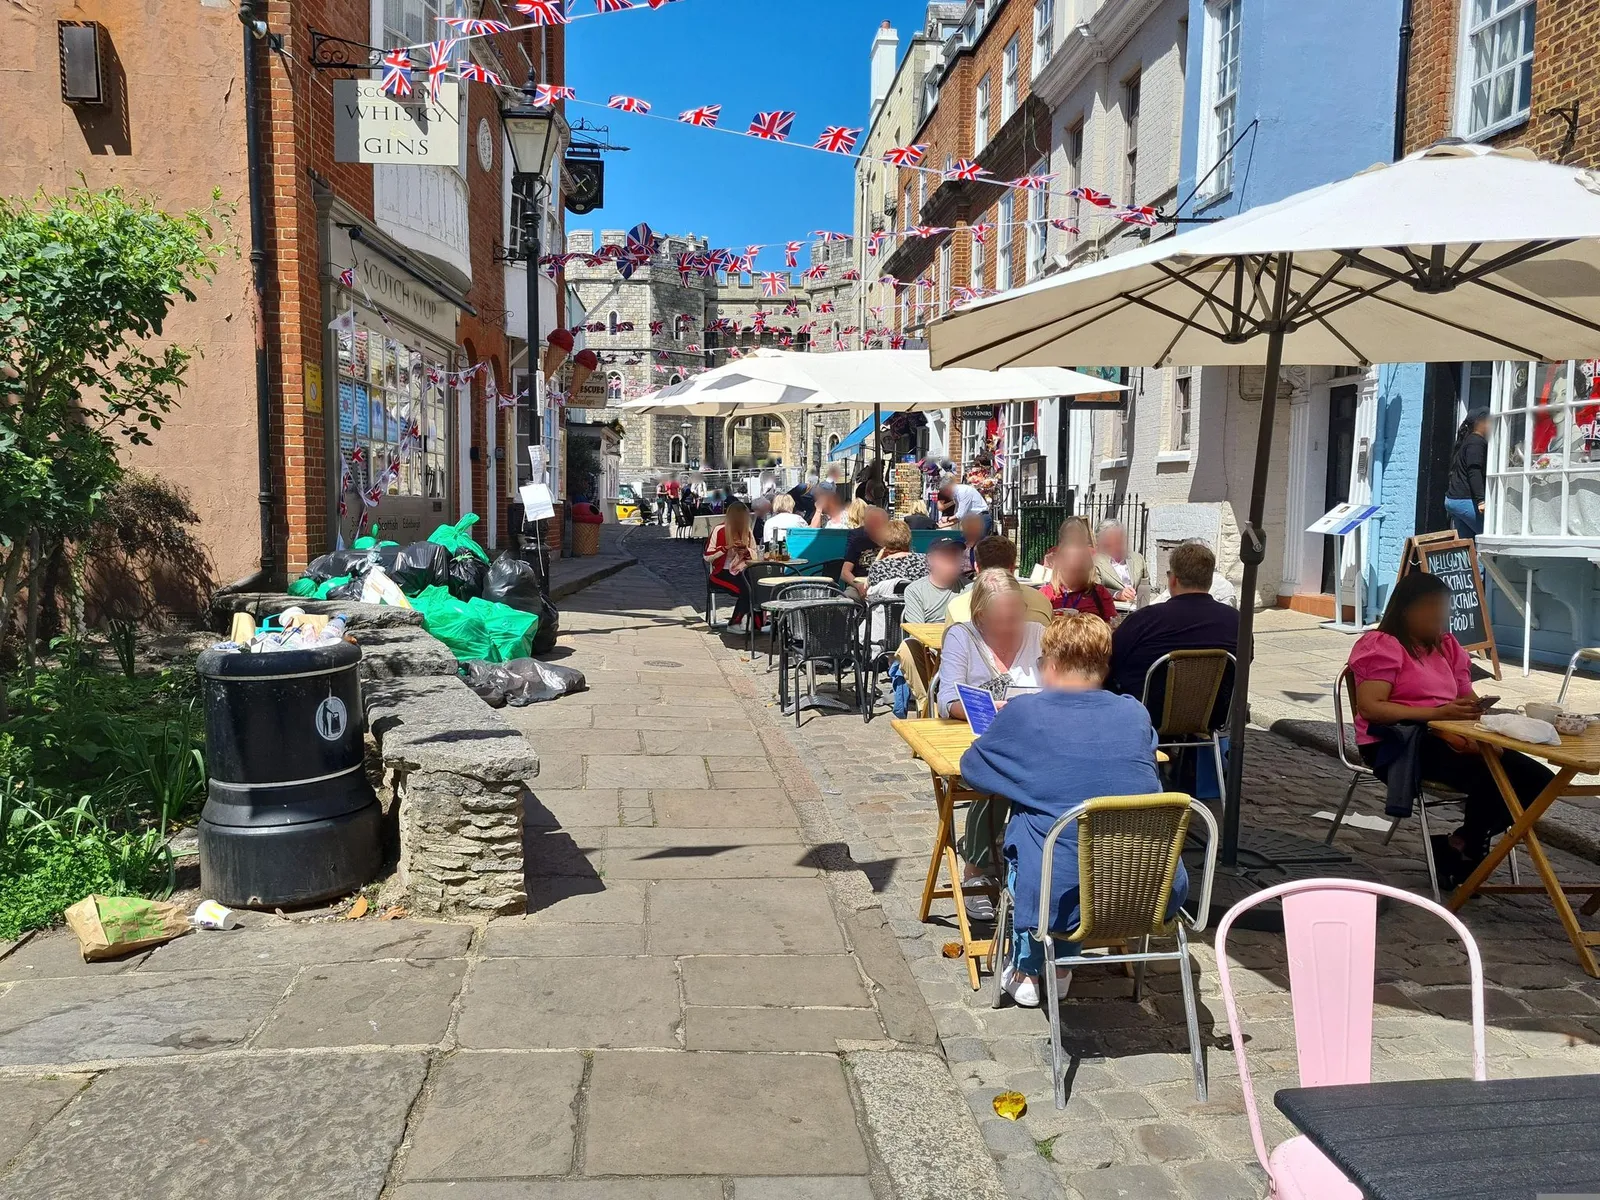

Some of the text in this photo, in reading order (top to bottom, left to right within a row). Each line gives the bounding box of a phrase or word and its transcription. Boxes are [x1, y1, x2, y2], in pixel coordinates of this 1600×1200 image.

[345, 104, 446, 122] WHISKY
[364, 137, 428, 155] GINS
[363, 258, 436, 323] SCOTCH STOP
[579, 385, 605, 394] ESCUES
[1449, 613, 1468, 634] FOOD
